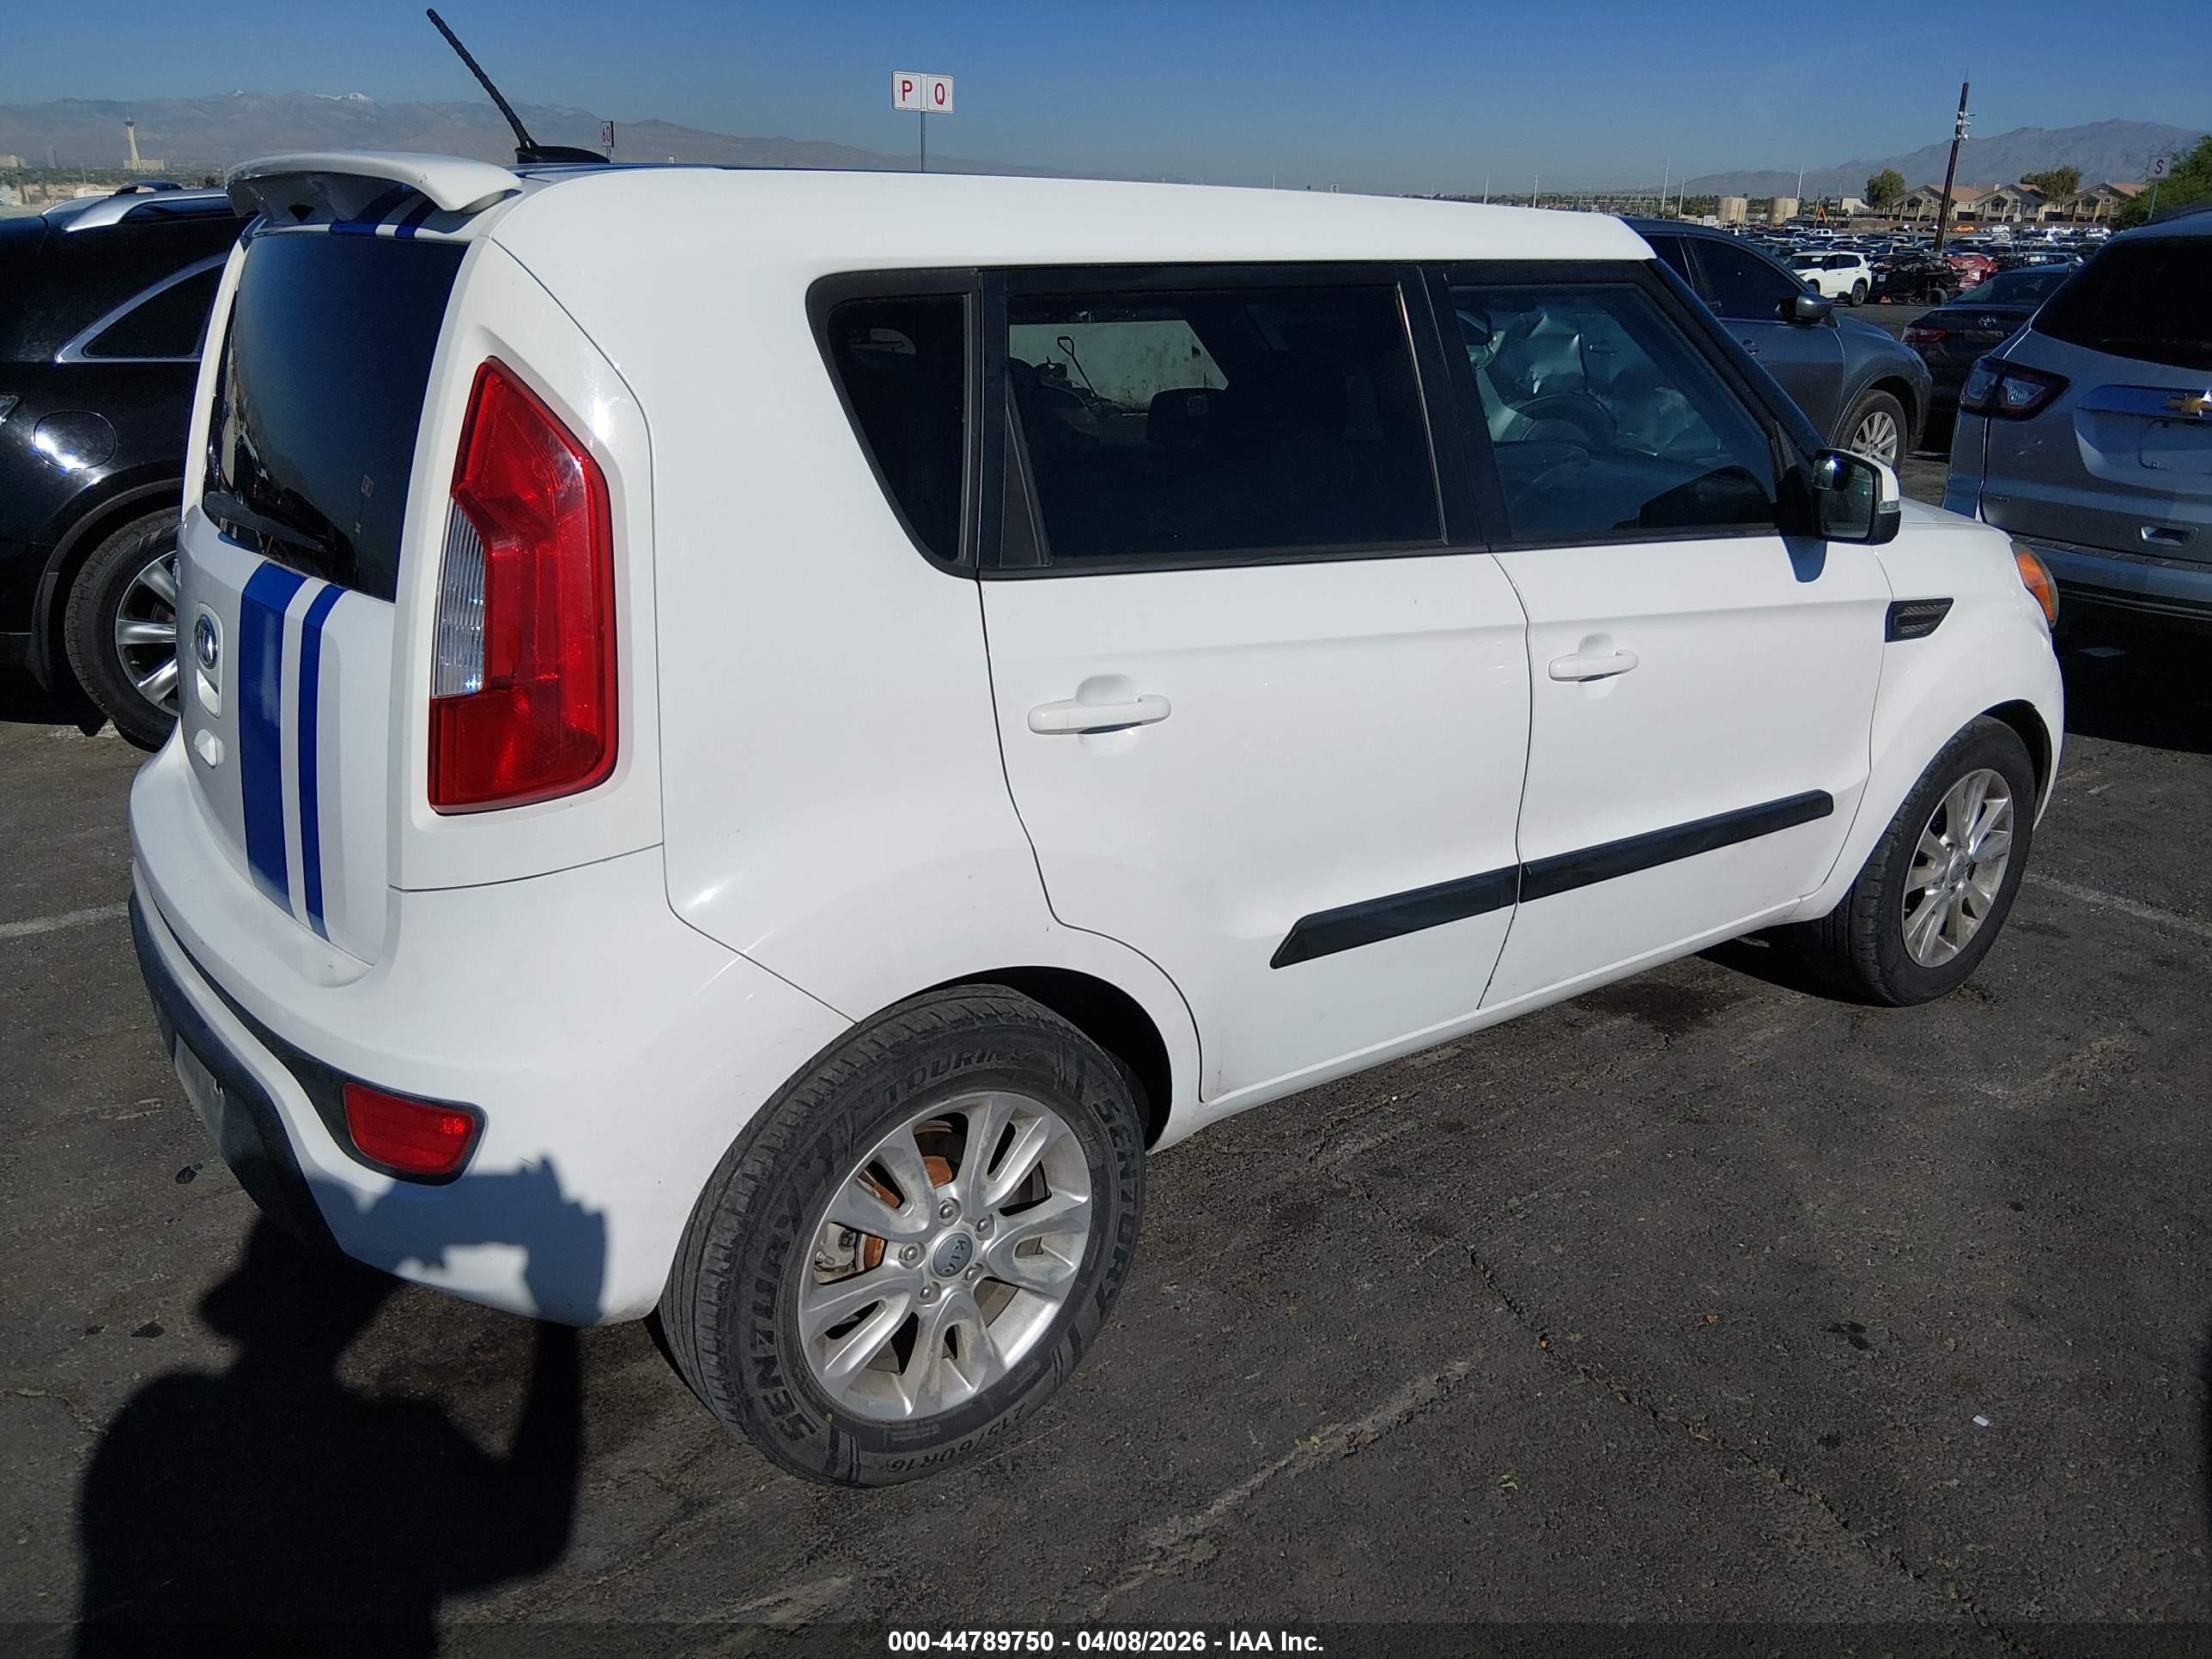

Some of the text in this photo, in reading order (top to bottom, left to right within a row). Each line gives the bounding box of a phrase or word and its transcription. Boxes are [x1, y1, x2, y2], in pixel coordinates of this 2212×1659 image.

[902, 80, 945, 106] P Q
[602, 125, 611, 143] 60
[2154, 159, 2165, 174] S
